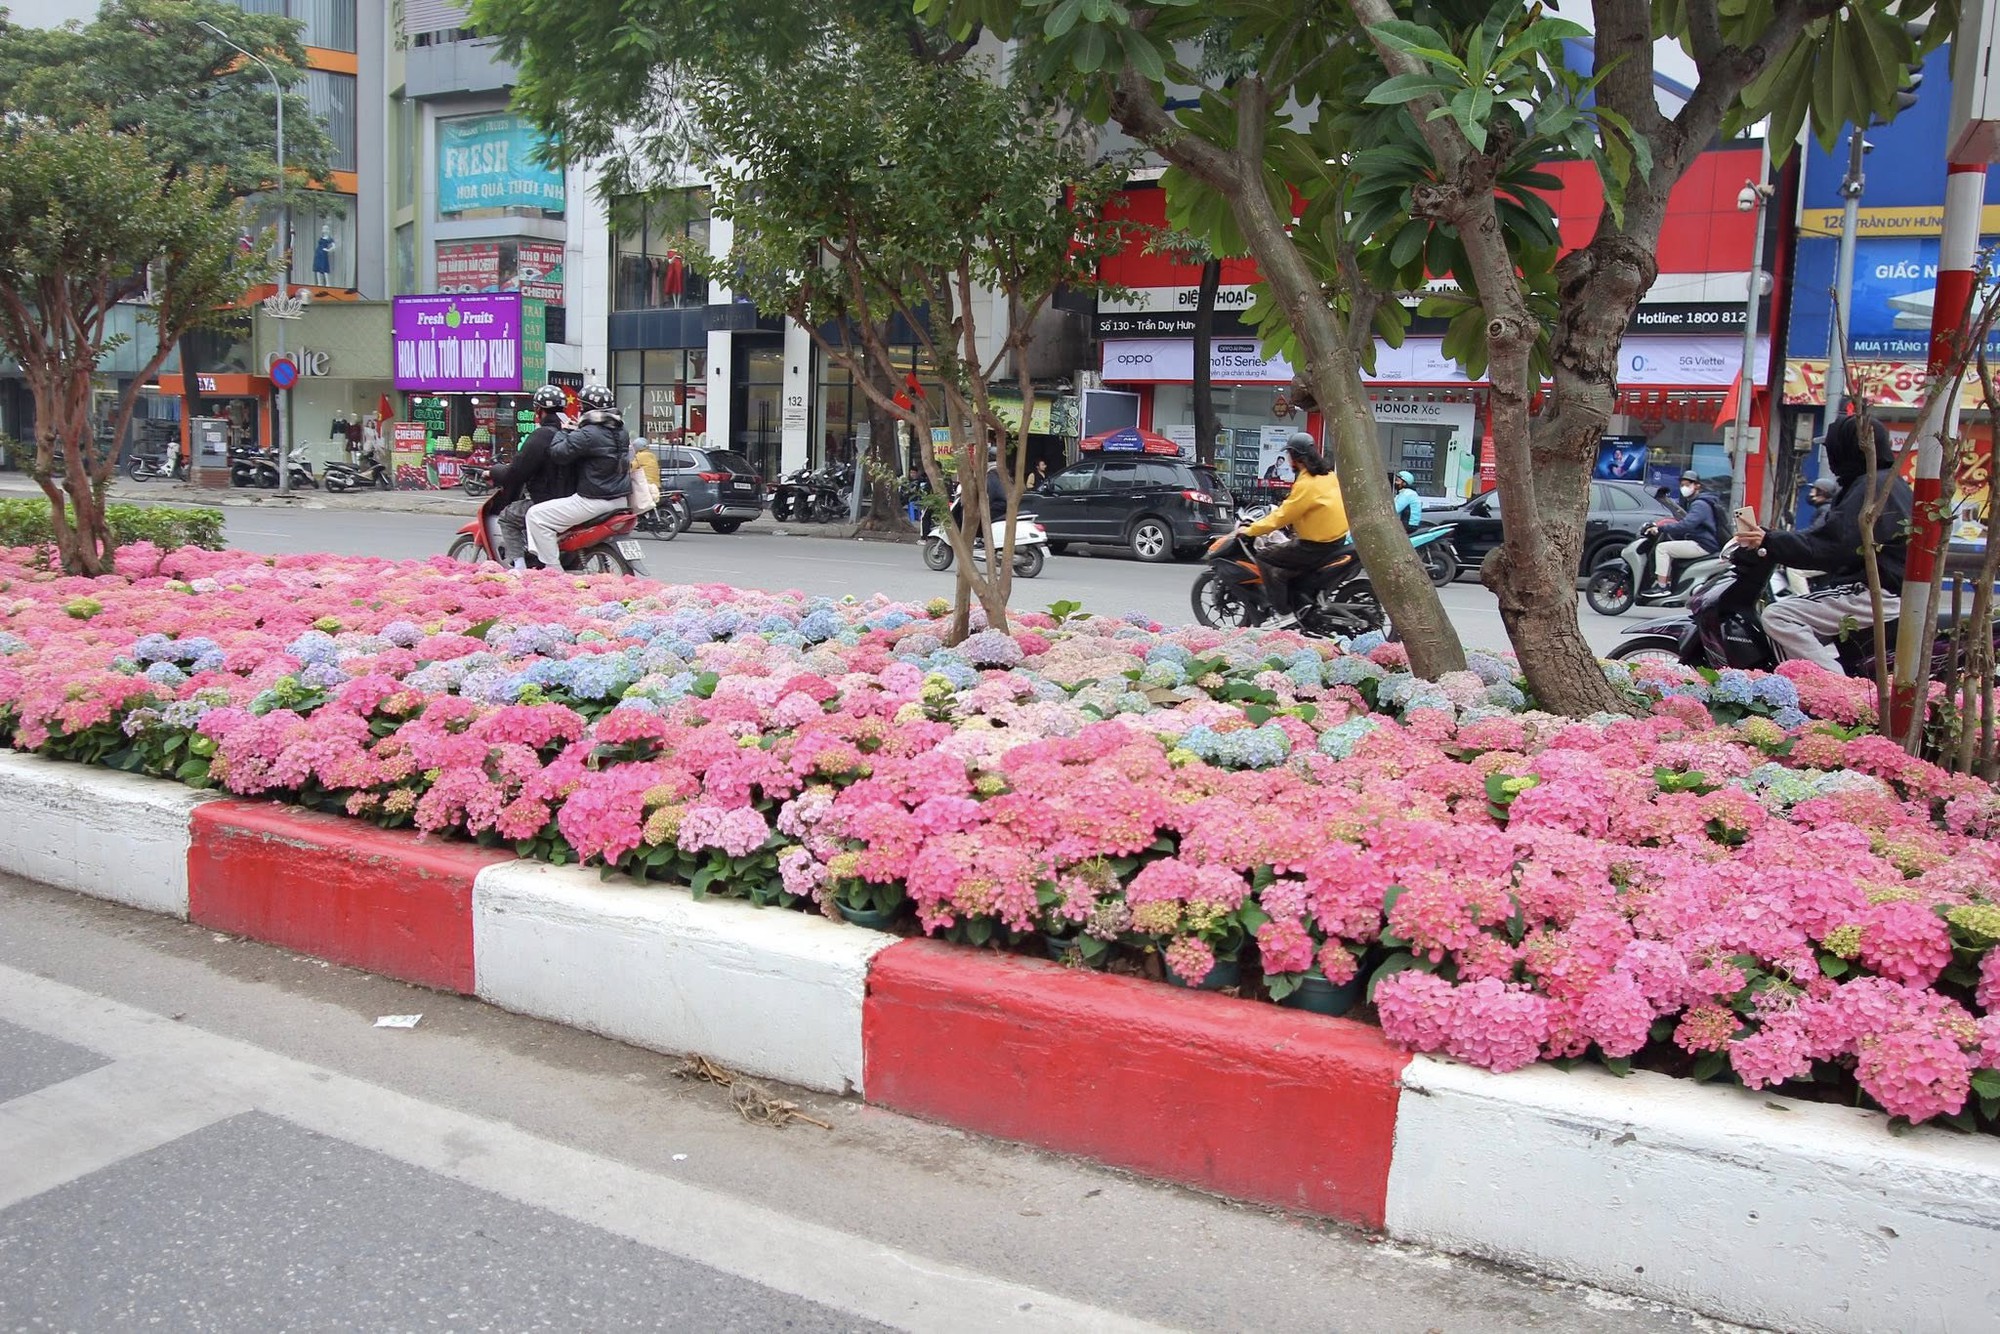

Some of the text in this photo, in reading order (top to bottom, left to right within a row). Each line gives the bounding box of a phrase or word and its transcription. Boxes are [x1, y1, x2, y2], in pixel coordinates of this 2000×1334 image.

[444, 140, 509, 178] FRESH
[1887, 217, 1911, 228] DUY
[1876, 260, 1919, 279] GIẤC
[521, 287, 562, 299] CHERRY
[1179, 289, 1198, 308] ĐIỆ
[1217, 289, 1247, 306] HOẠI
[417, 311, 494, 325] Fresh Fruits
[1637, 312, 1683, 324] Hotline:
[1686, 312, 1718, 323] 1800
[1100, 320, 1111, 331] Số
[1113, 321, 1129, 331] 130
[1137, 318, 1156, 331] Trần
[1158, 320, 1174, 332] Duy
[1177, 319, 1195, 330] Hưn
[1855, 341, 1881, 351] MUA
[1883, 341, 1888, 351] 1
[1889, 339, 1921, 353] TẶNG
[398, 322, 515, 387] HOA QUẢ TƯƠI NHẬP KHẨU
[1117, 354, 1153, 366] oppo
[1679, 356, 1725, 365] 5G Viettel
[1210, 355, 1267, 367] no15 Series
[651, 390, 675, 403] YEAR
[788, 396, 803, 407] 132
[653, 405, 673, 418] END
[1375, 403, 1441, 415] HONOR X6c
[647, 421, 675, 433] PARTY
[395, 429, 426, 440] CHERRY
[1727, 636, 1753, 644] HONDA
